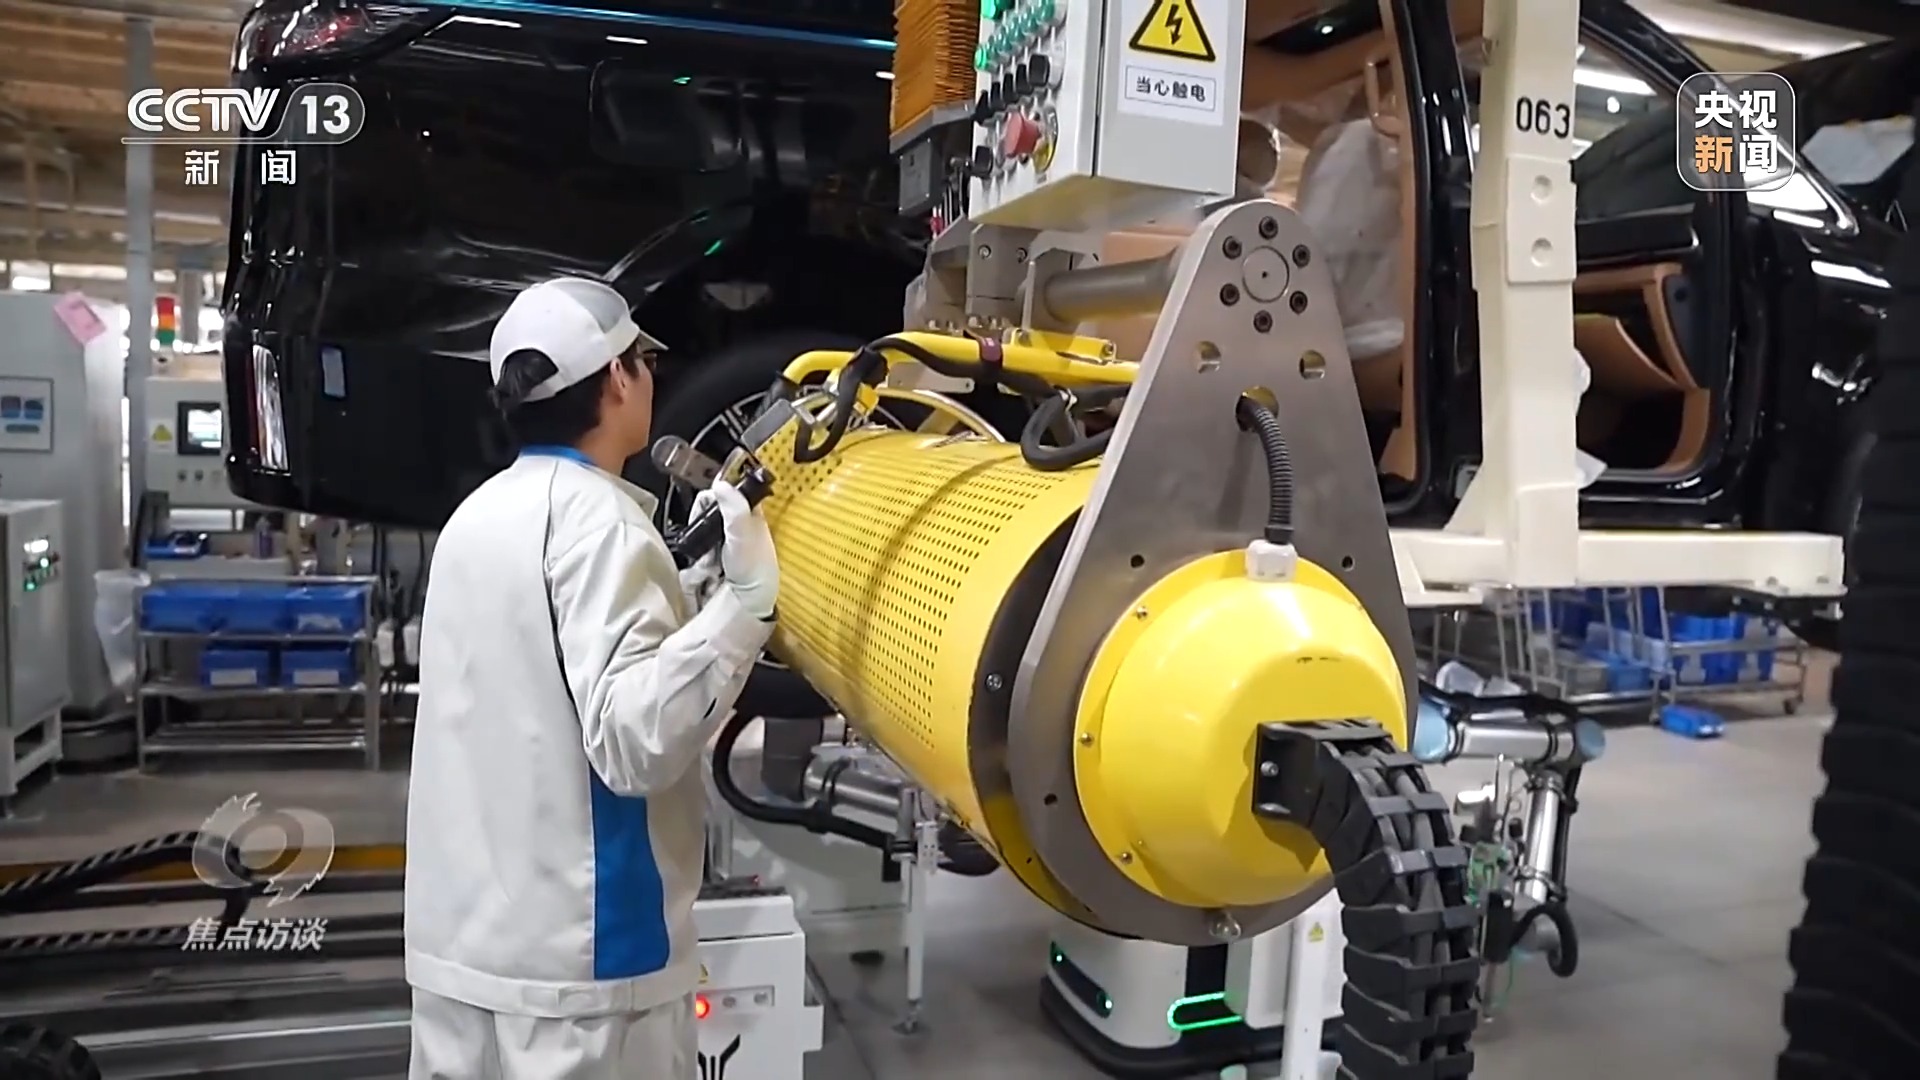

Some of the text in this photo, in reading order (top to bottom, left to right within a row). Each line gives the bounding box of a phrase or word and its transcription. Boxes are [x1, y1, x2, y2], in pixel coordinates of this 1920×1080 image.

[1136, 76, 1206, 102] 当心触电
[1516, 97, 1570, 139] 063
